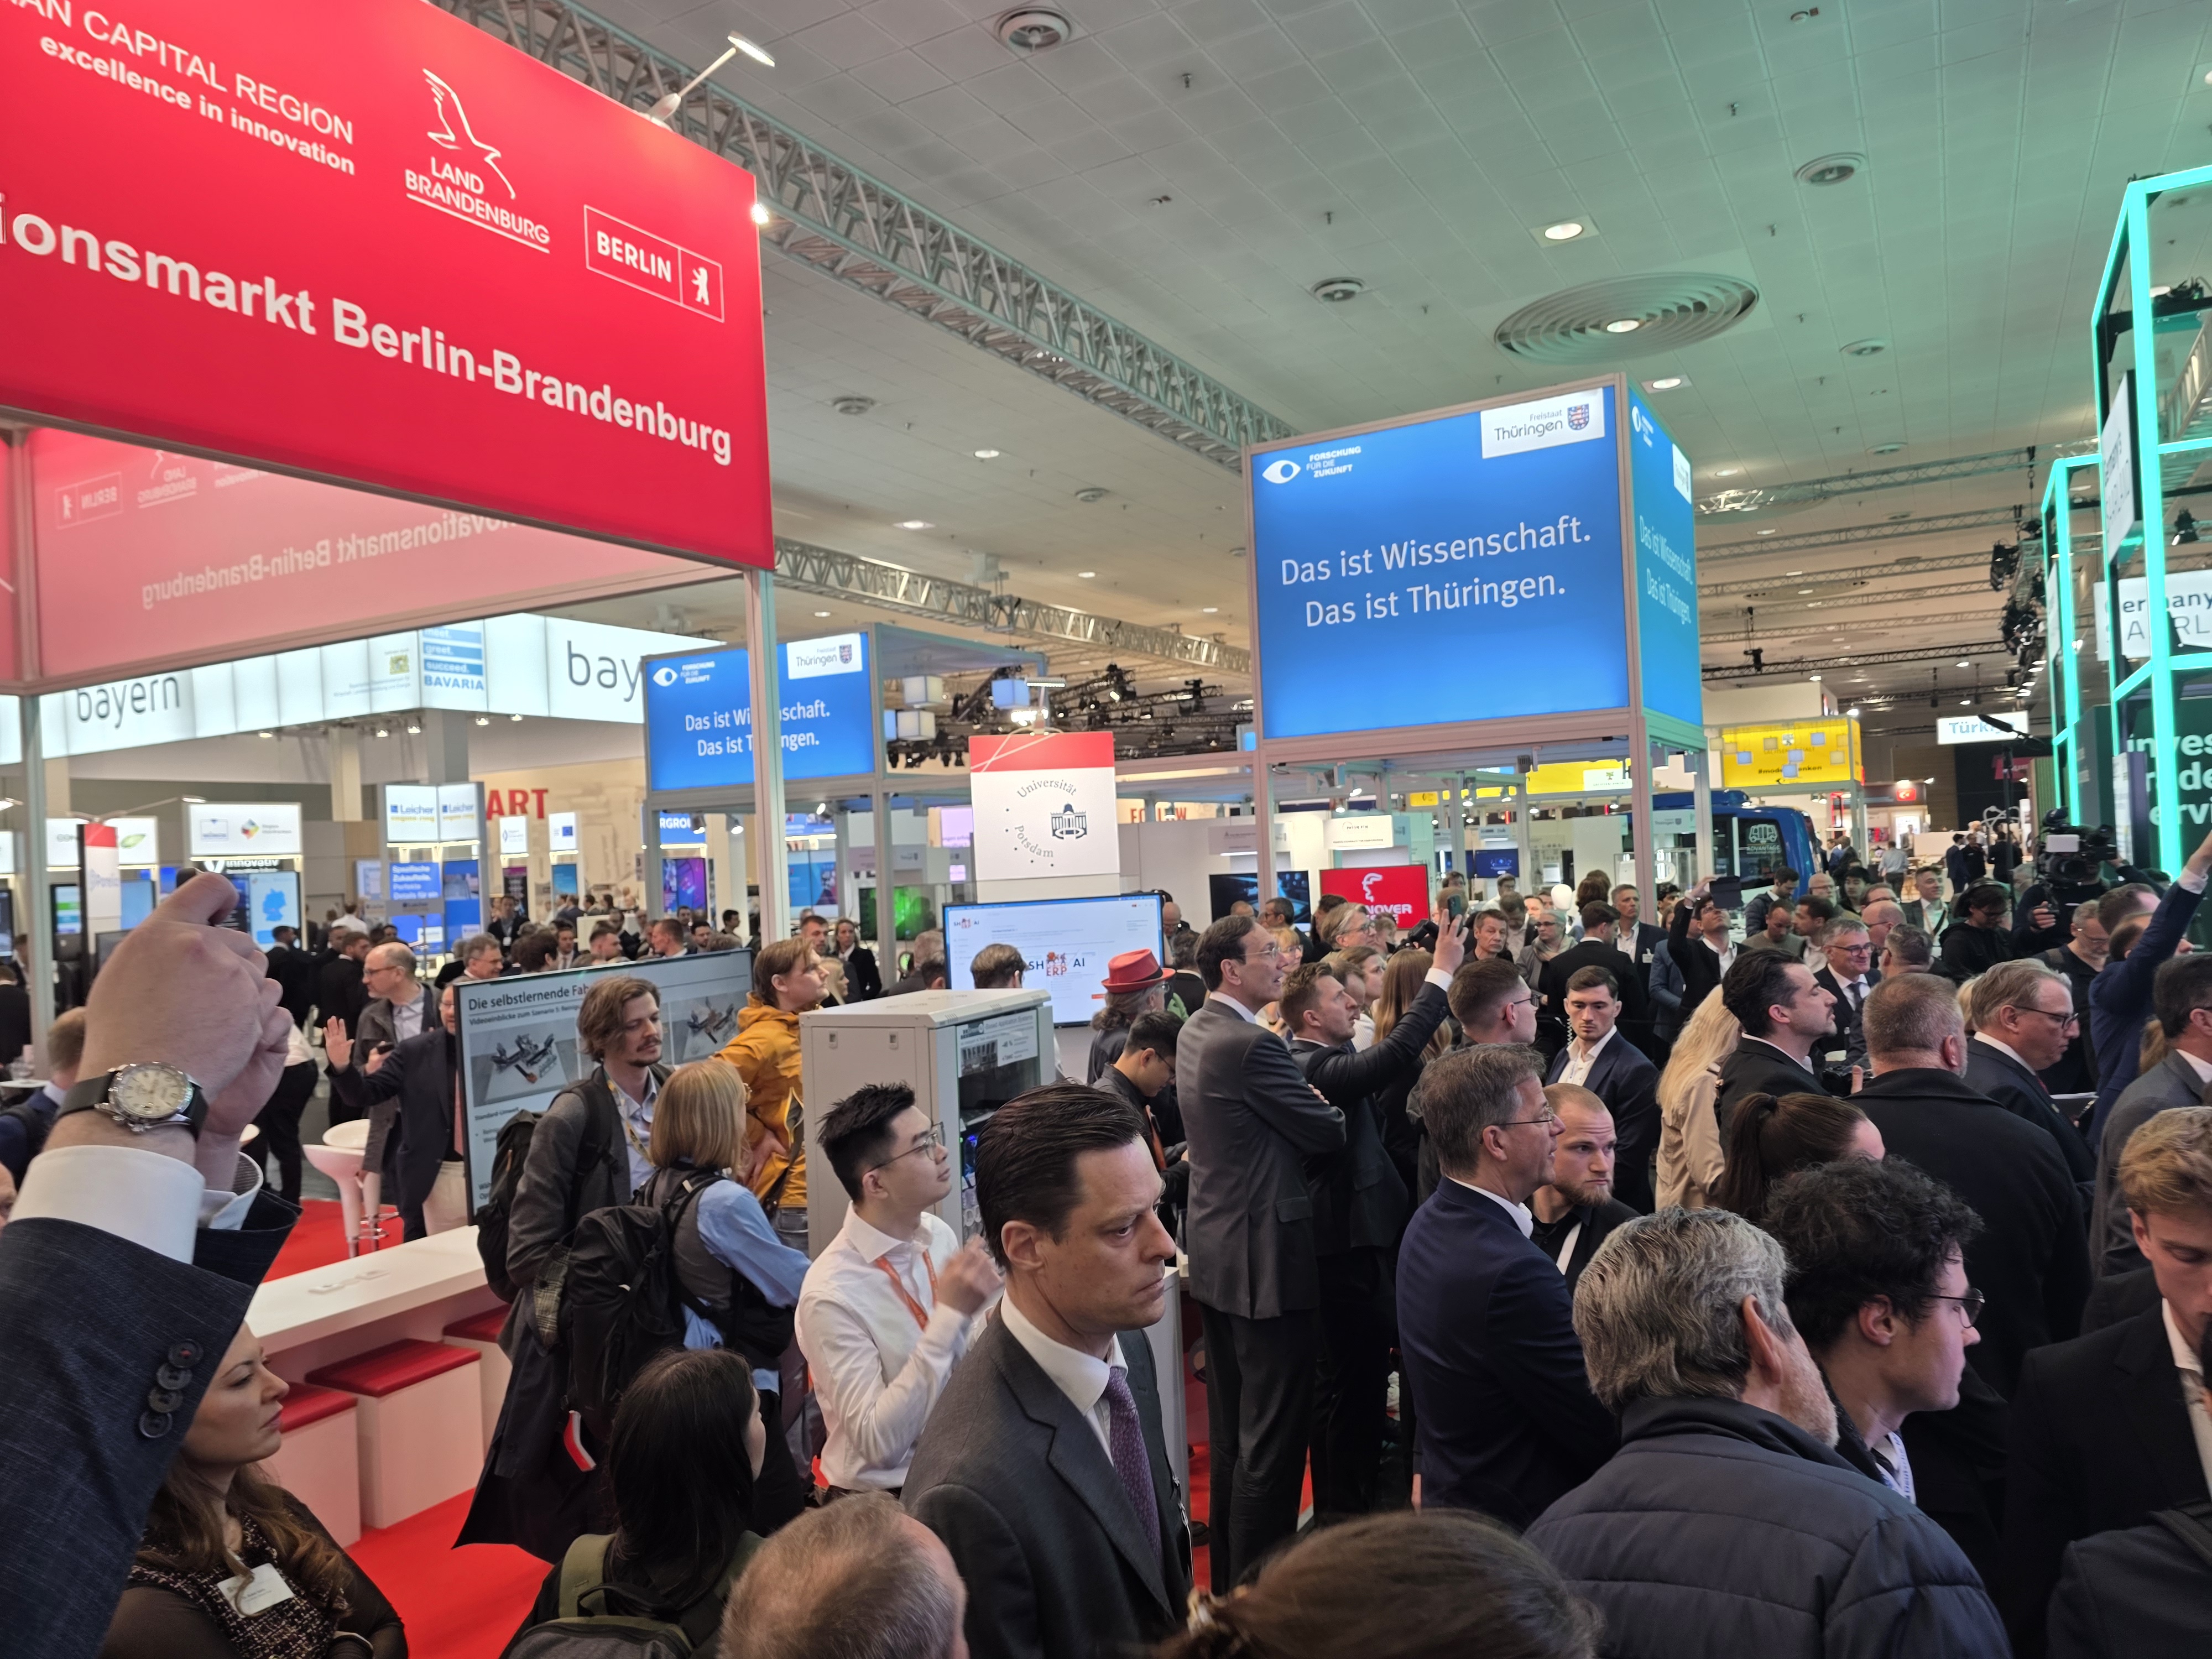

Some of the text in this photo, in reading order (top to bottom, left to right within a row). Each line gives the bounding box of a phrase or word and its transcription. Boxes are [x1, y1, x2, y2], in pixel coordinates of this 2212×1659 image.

[84, 11, 227, 92] CAPITAL
[236, 73, 353, 144] REGION
[40, 36, 354, 175] excellence in innovation
[430, 156, 484, 194] LAND
[405, 169, 550, 244] BRANDENBURG
[597, 231, 671, 283] BERLIN
[333, 298, 731, 466] Berlin-Brandenburg
[1530, 409, 1563, 422] Freistaat
[1494, 418, 1563, 441] Thüringen
[1306, 458, 1335, 471] FÜR DIE
[1309, 446, 1361, 462] FORSCHUNG
[1313, 463, 1353, 478] ZUKUNFT
[1281, 515, 1590, 585] Das ist Wissenschaft.
[1306, 573, 1566, 627] Das ist Thüringen.
[796, 654, 837, 667] Thüringen
[424, 674, 484, 691] BAVARIA
[685, 714, 710, 731] Das
[713, 711, 731, 728] ist
[697, 739, 723, 757] Das
[726, 737, 743, 753] ist
[1016, 780, 1077, 799] Universität
[1014, 825, 1054, 858] Potsdam
[1073, 958, 1085, 967] AI
[468, 998, 488, 1011] Die
[491, 987, 570, 1008] selbstlernende
